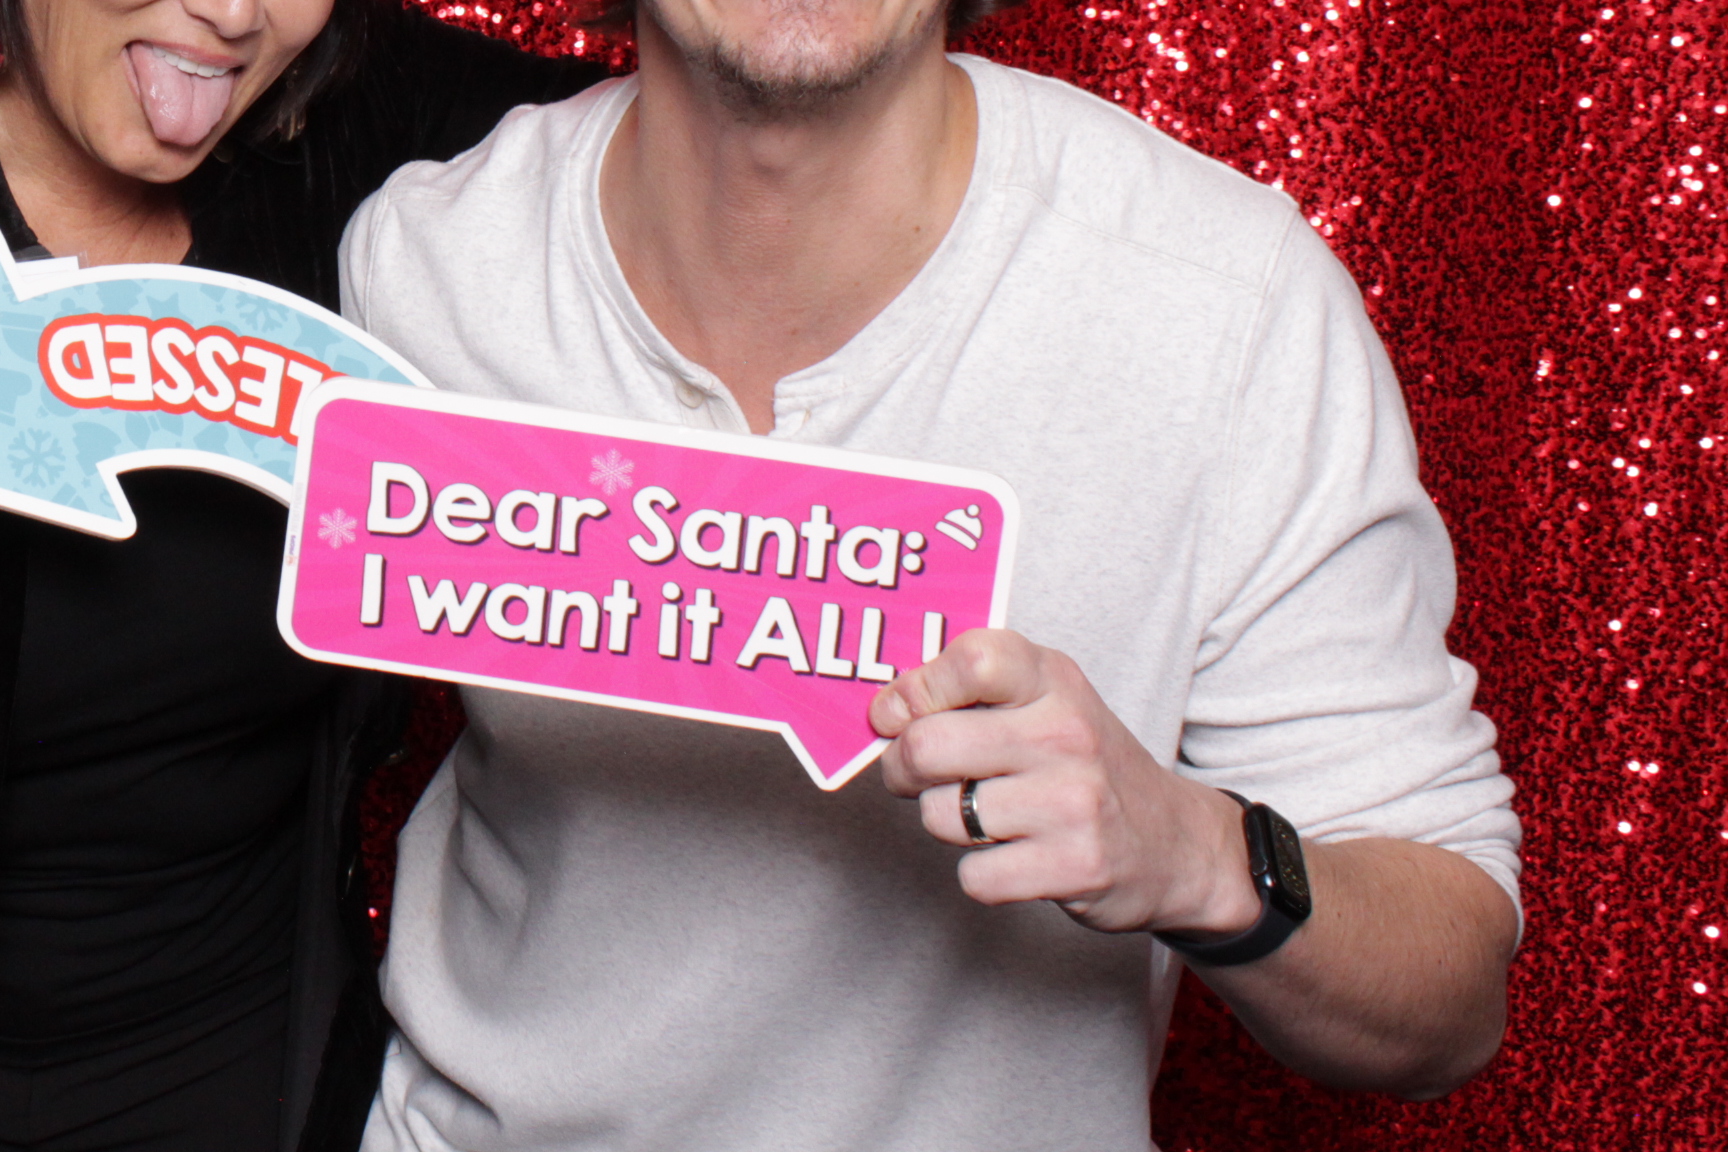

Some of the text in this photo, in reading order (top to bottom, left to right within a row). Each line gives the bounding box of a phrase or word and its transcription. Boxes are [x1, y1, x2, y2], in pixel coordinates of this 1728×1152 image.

[47, 323, 323, 437] LESSED
[367, 461, 609, 553] Dear
[628, 485, 927, 588] Santa:
[360, 553, 384, 624] I
[407, 575, 638, 653] want
[658, 581, 720, 661] it
[736, 596, 896, 683] ALL
